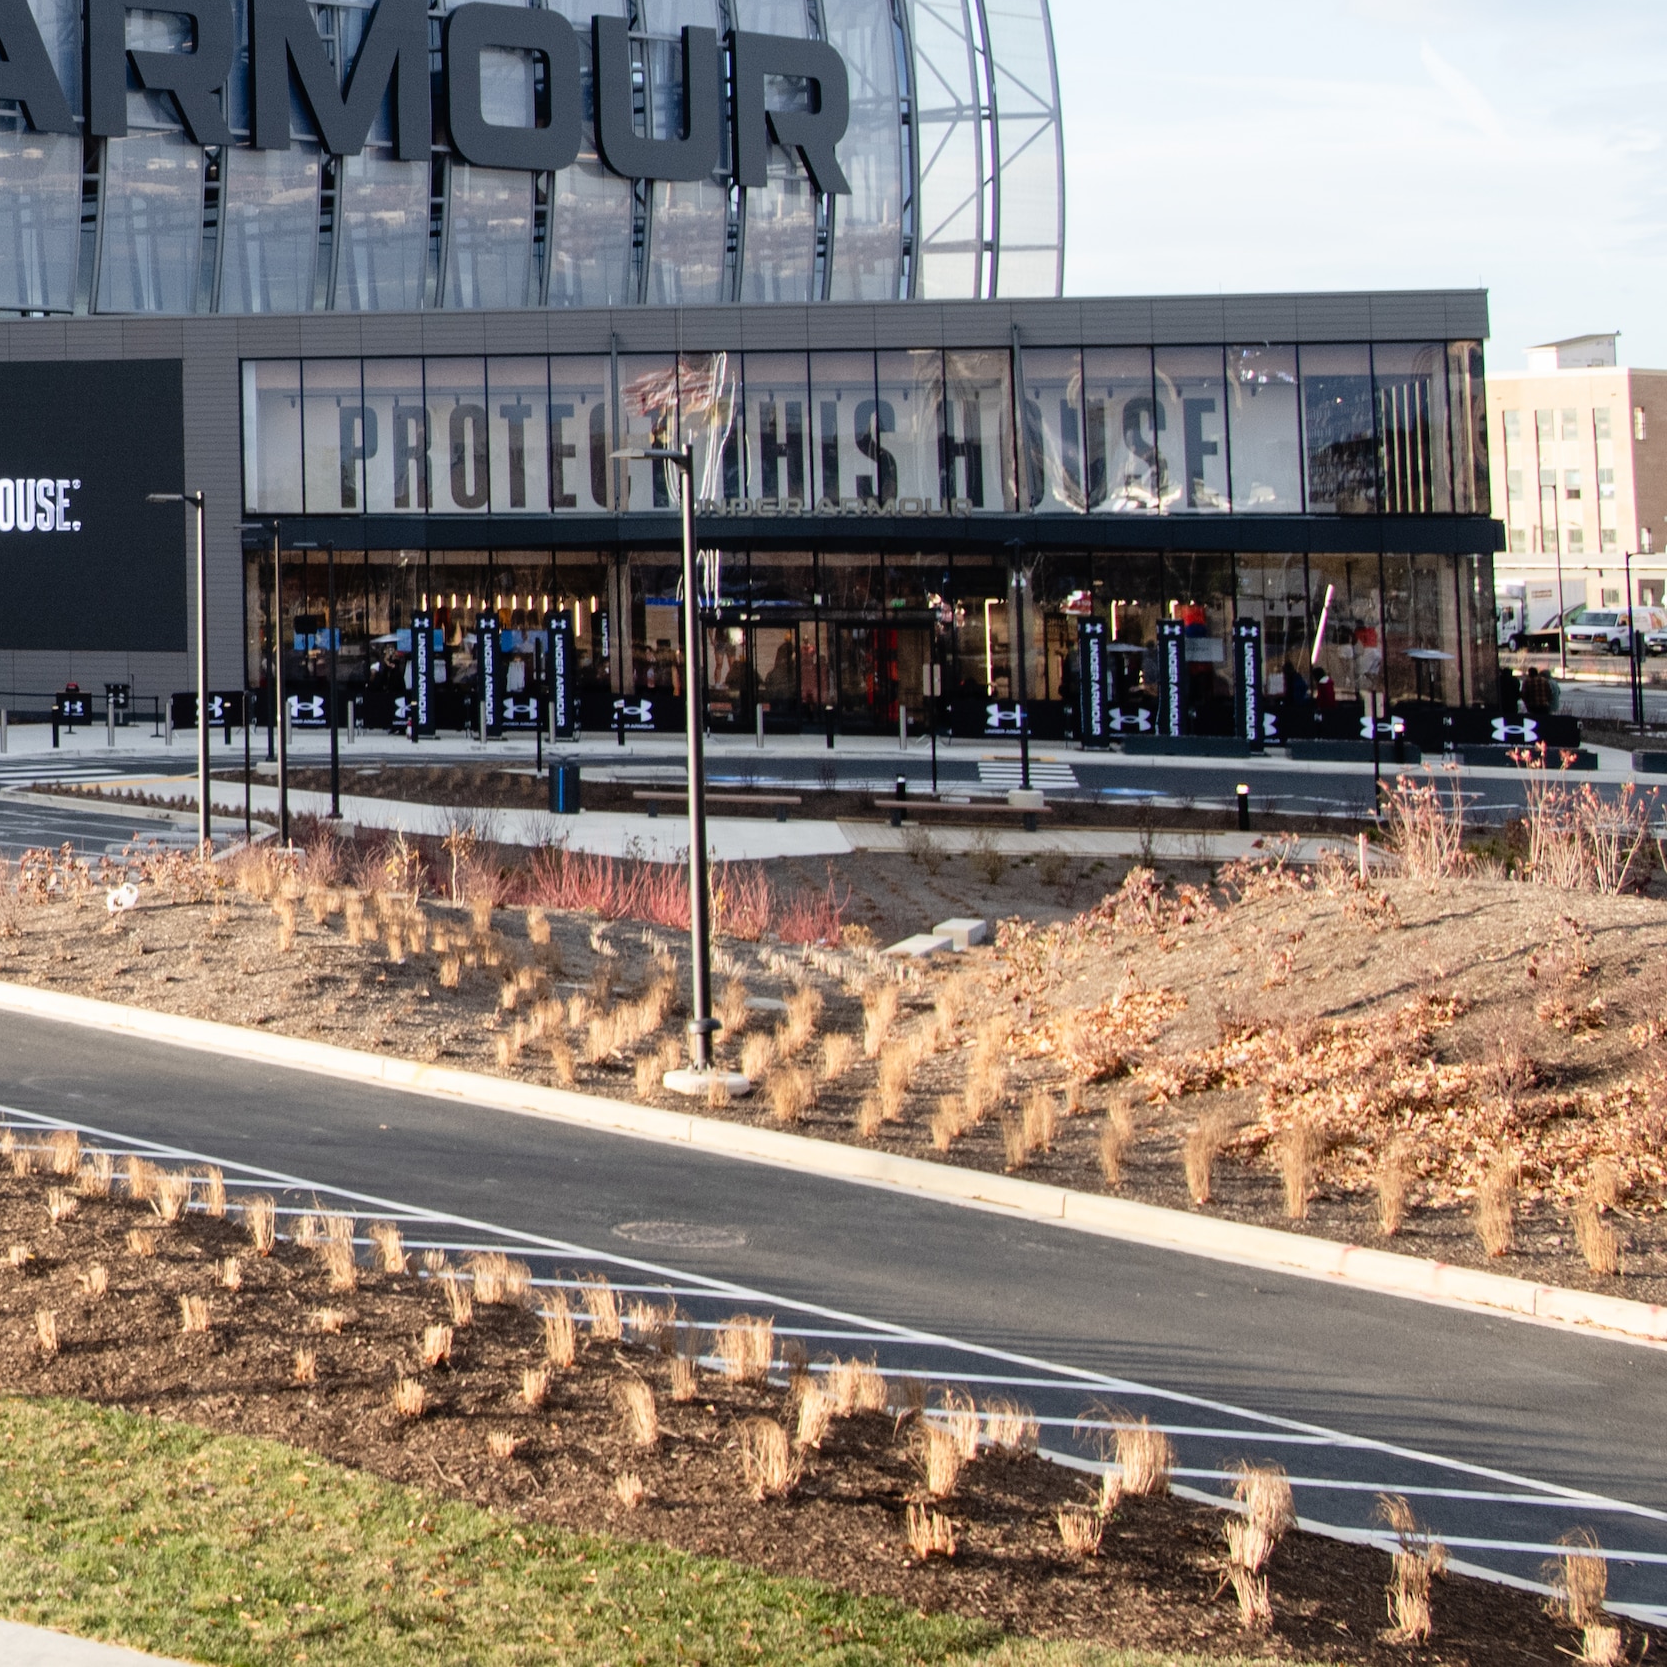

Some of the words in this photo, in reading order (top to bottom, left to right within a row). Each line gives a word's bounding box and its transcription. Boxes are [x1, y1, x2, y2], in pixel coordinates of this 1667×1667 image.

[816, 497, 973, 518] ARMOUR
[418, 633, 427, 672] UNDER
[483, 633, 492, 673] UNDER
[554, 634, 564, 674] UNDER
[1089, 638, 1099, 680] UNDER
[1168, 640, 1177, 683] UNDER
[1244, 642, 1254, 685] UNDER
[418, 673, 427, 724] ARMOUR
[485, 674, 494, 725] ARMOUR
[555, 675, 565, 727] ARMOUR
[1091, 681, 1101, 735] ARMOUR
[1246, 686, 1256, 740] ARMOUR
